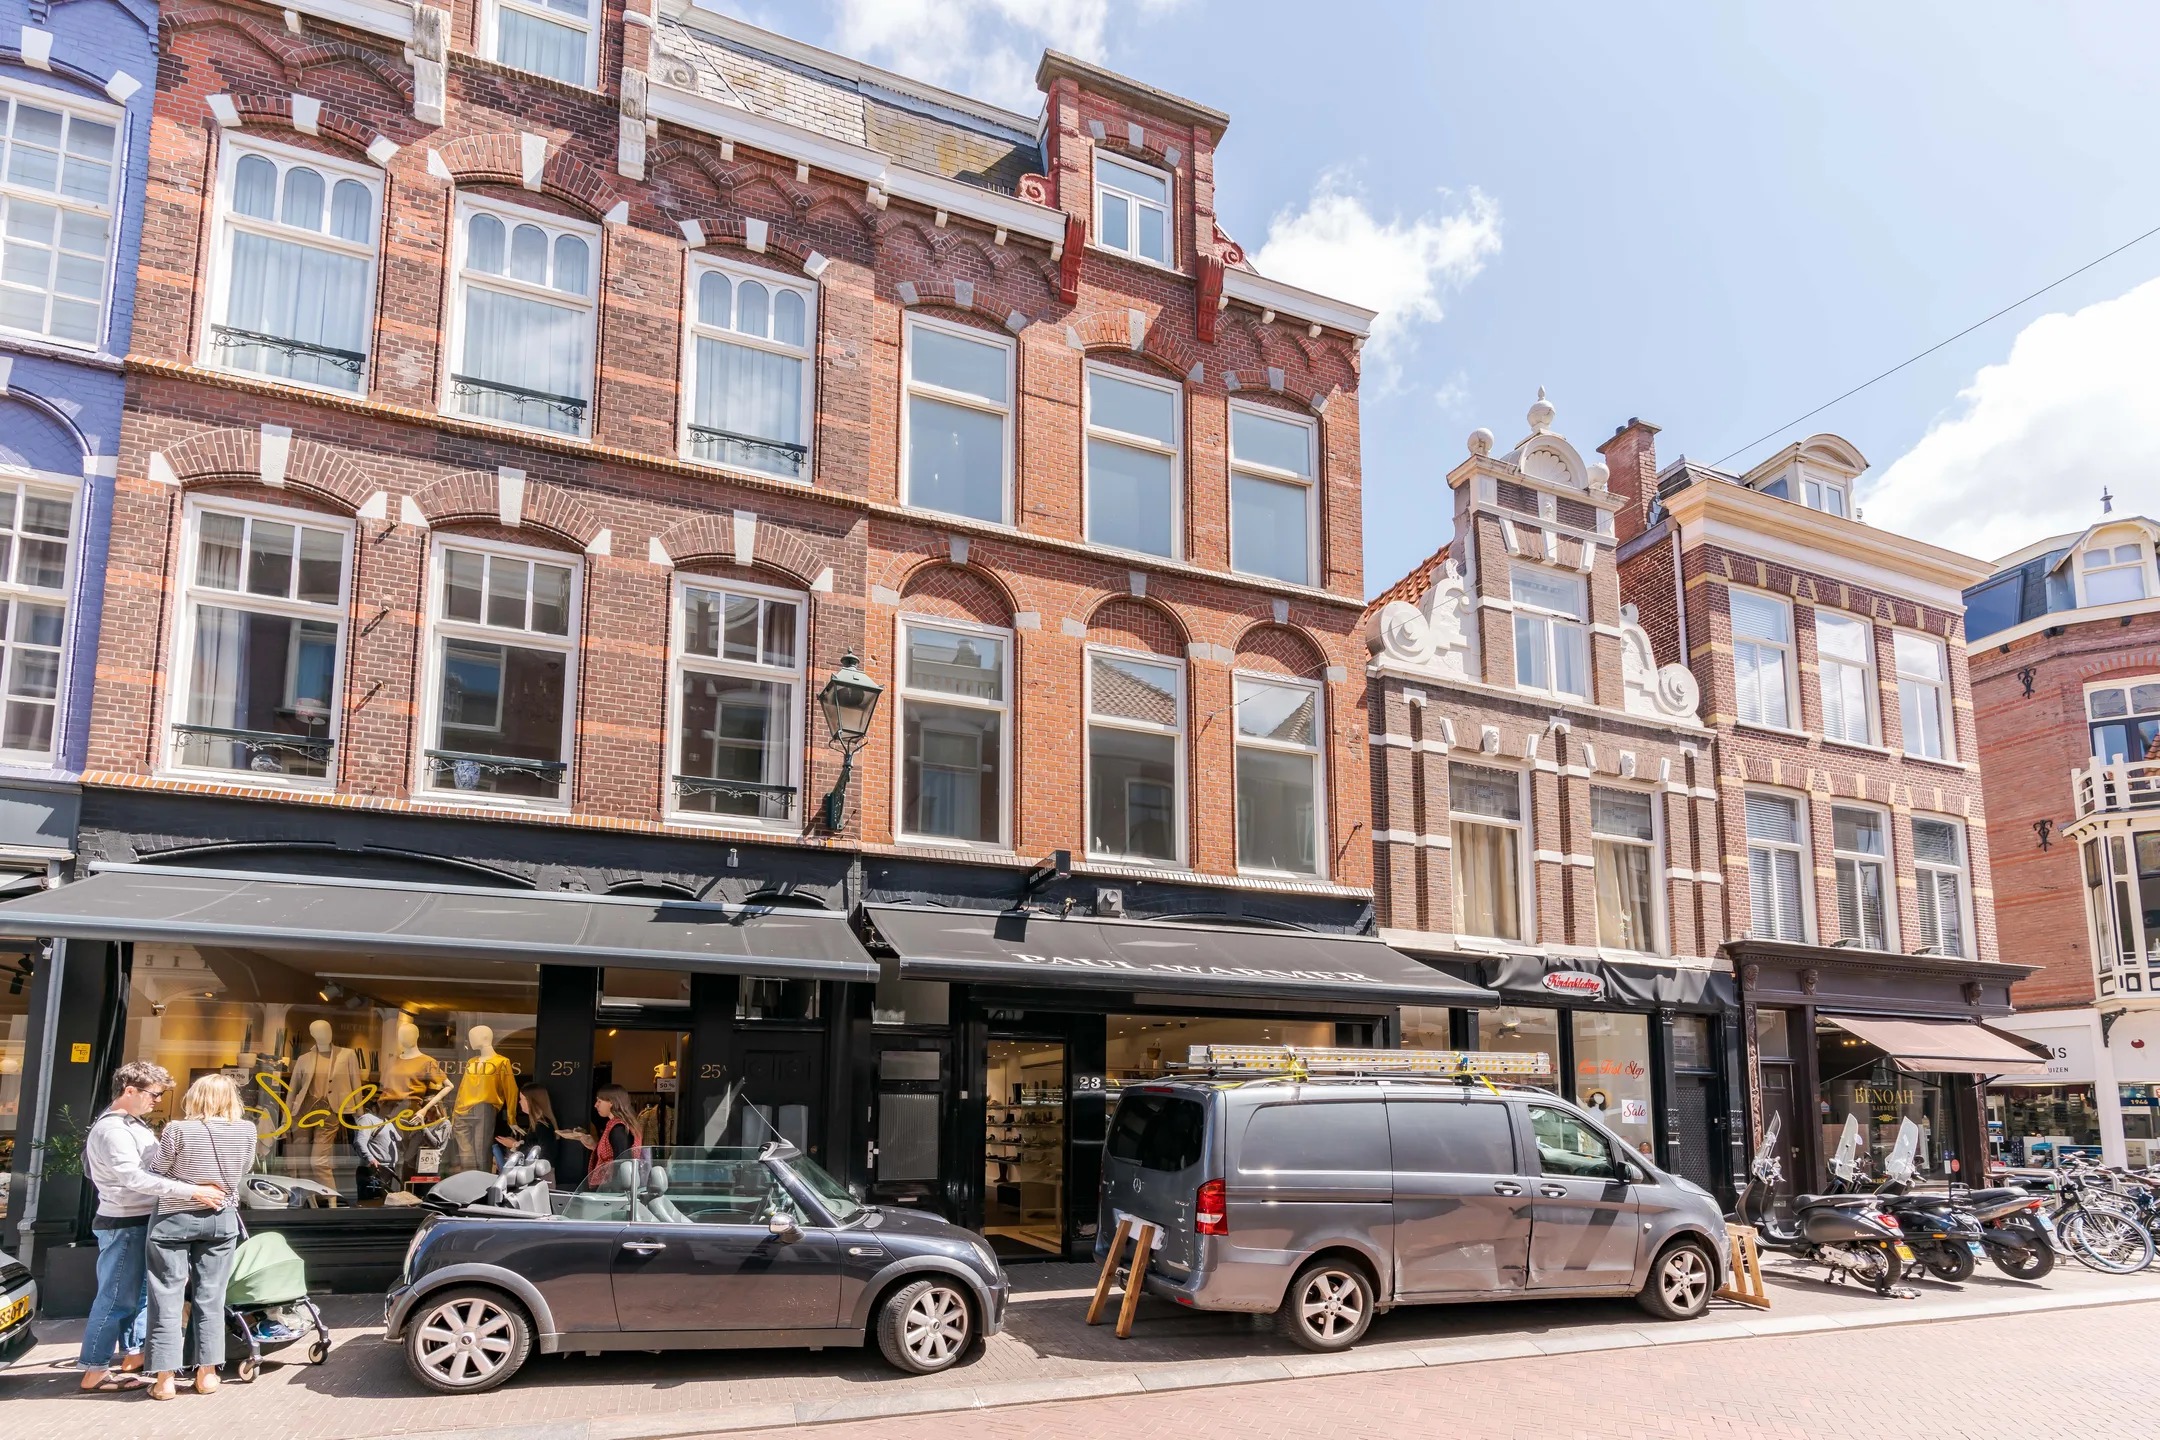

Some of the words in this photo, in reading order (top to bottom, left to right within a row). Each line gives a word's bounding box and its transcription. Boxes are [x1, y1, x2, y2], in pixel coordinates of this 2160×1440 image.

[1012, 953, 1135, 969] PAUL
[1149, 964, 1383, 982] WARMER
[1547, 974, 1601, 992] Kinderkleding
[426, 1060, 522, 1076] HERIDAS
[1625, 1060, 1645, 1079] Step
[1079, 1076, 1101, 1089] 23
[1854, 1088, 1915, 1105] BENOAH
[243, 1072, 449, 1139] Sale
[1623, 1103, 1646, 1118] Sale
